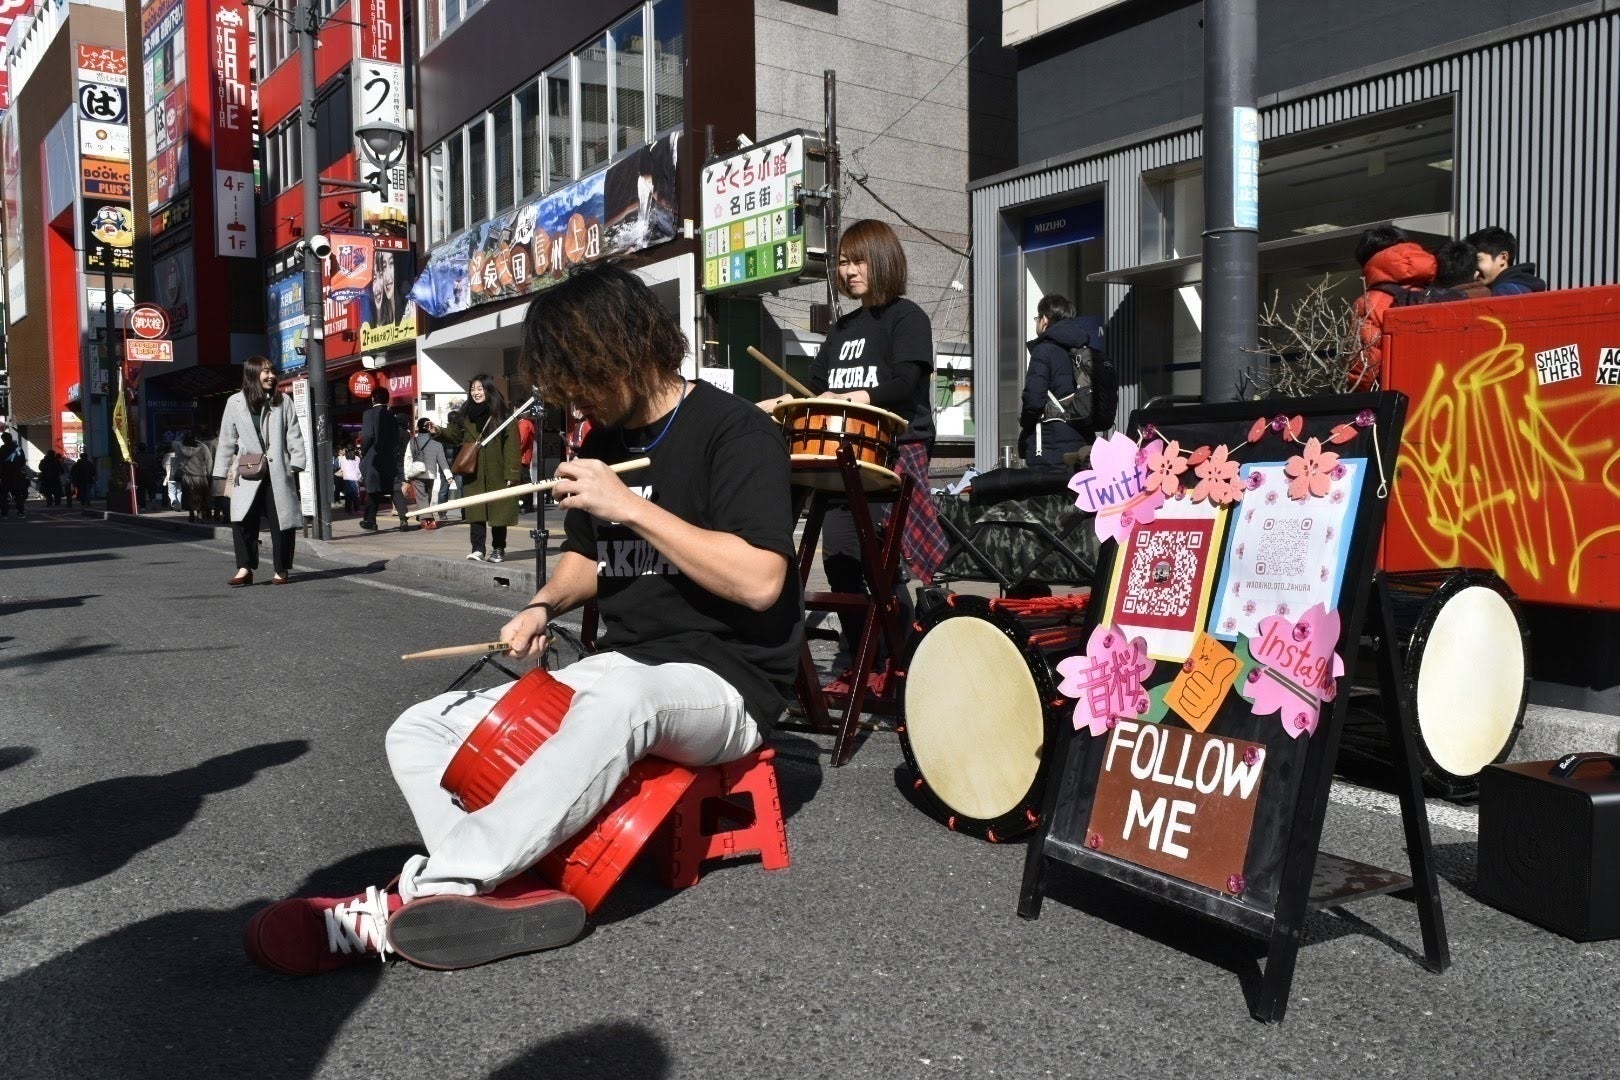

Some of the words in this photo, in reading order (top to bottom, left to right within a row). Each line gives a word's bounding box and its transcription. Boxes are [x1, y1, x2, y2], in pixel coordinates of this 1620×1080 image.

[216, 26, 224, 69] TAITO
[223, 27, 246, 130] GAME
[363, 69, 391, 115] う
[86, 90, 117, 117] は
[716, 153, 788, 195] さくら小路
[729, 185, 771, 216] 名店街
[1034, 219, 1066, 233] MIZUHO
[535, 218, 600, 273] 信州上田
[134, 317, 162, 330] 消火栓
[838, 337, 866, 361] OTO
[1537, 345, 1578, 369] SHARK
[354, 383, 372, 392] GAME
[1538, 361, 1581, 384] THER
[1105, 720, 1267, 801] FOLLOW
[1122, 788, 1197, 860] ME
